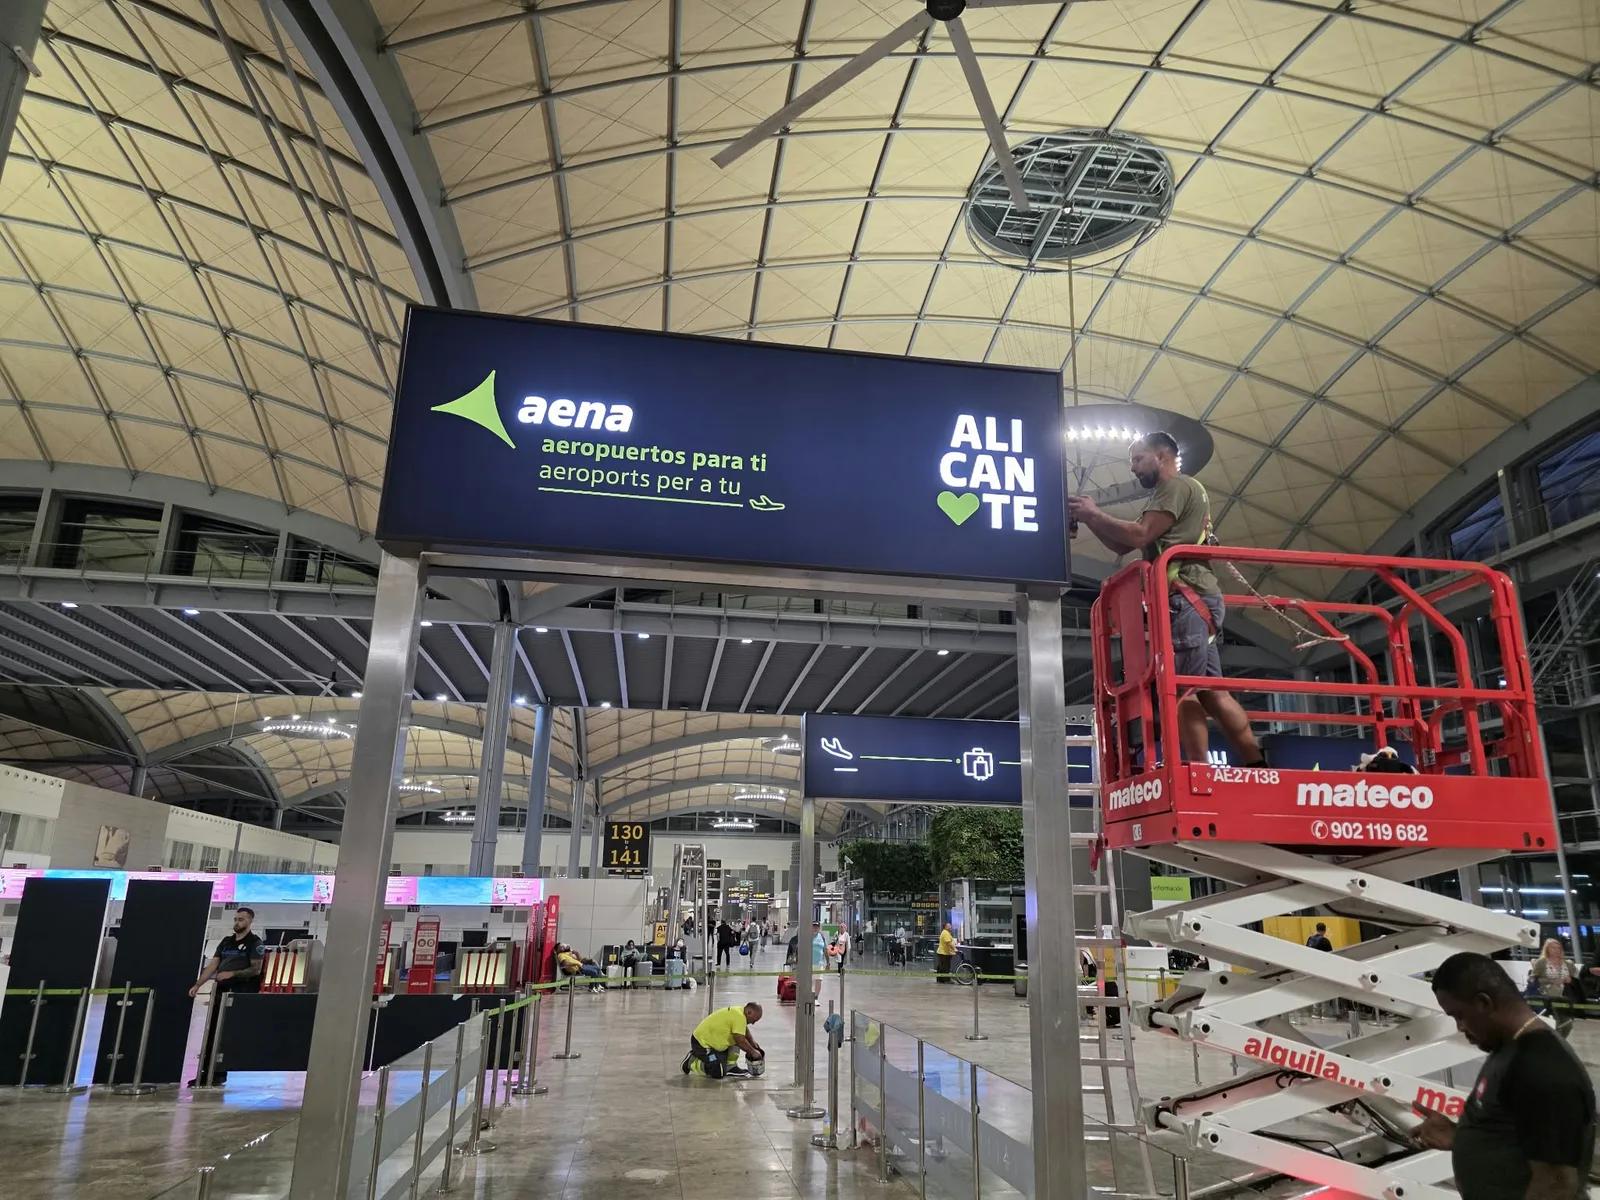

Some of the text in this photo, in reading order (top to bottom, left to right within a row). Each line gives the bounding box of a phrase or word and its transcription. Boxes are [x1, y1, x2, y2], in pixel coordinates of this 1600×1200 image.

[517, 395, 634, 433] aena
[950, 414, 1023, 453] ALI
[541, 438, 767, 472] aeropuertos para ti
[539, 464, 741, 495] aeroports per a tu
[940, 452, 1035, 493] CAN
[982, 493, 1039, 532] TE
[1213, 769, 1280, 785] AE27138
[1109, 778, 1163, 811] mateco
[1297, 780, 1434, 809] mateco
[611, 824, 643, 840] 130
[1330, 821, 1429, 842] 902 119 682
[610, 849, 641, 865] 141
[1243, 1037, 1365, 1090] alquila...
